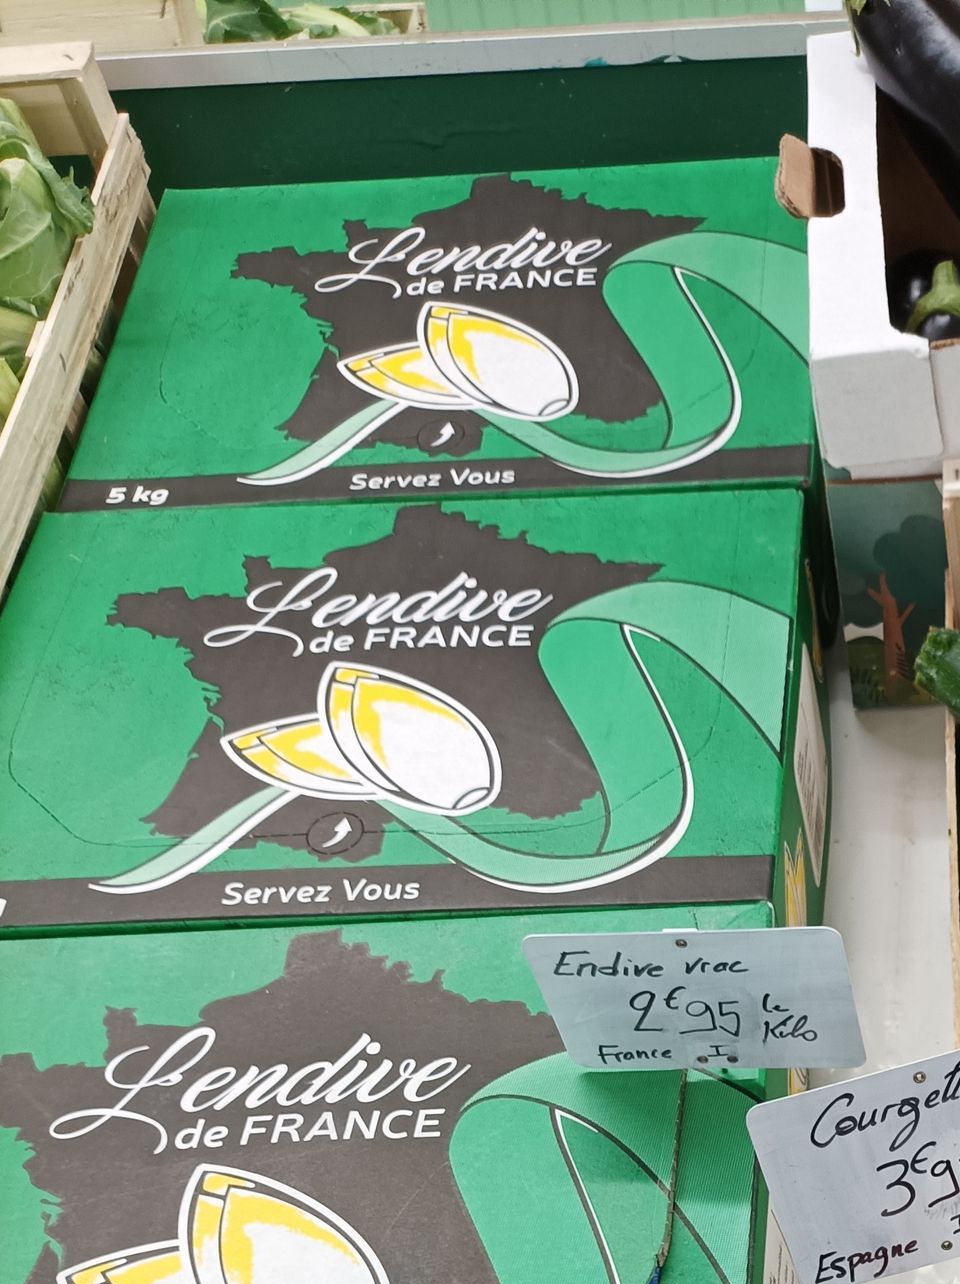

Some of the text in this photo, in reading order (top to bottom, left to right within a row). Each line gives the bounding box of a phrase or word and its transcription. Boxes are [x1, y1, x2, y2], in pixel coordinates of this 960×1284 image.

[406, 267, 598, 296] de FRANCE
[348, 468, 516, 491] Servez Vous
[105, 486, 169, 506] 5 kg
[309, 624, 535, 654] de FRANCE
[221, 878, 421, 906] Servez Vous
[553, 950, 665, 978] Endive
[762, 1014, 818, 1045] Kilo
[597, 1044, 673, 1065] France
[174, 1108, 446, 1150] de FRANCE
[815, 1239, 919, 1284] Espagne
